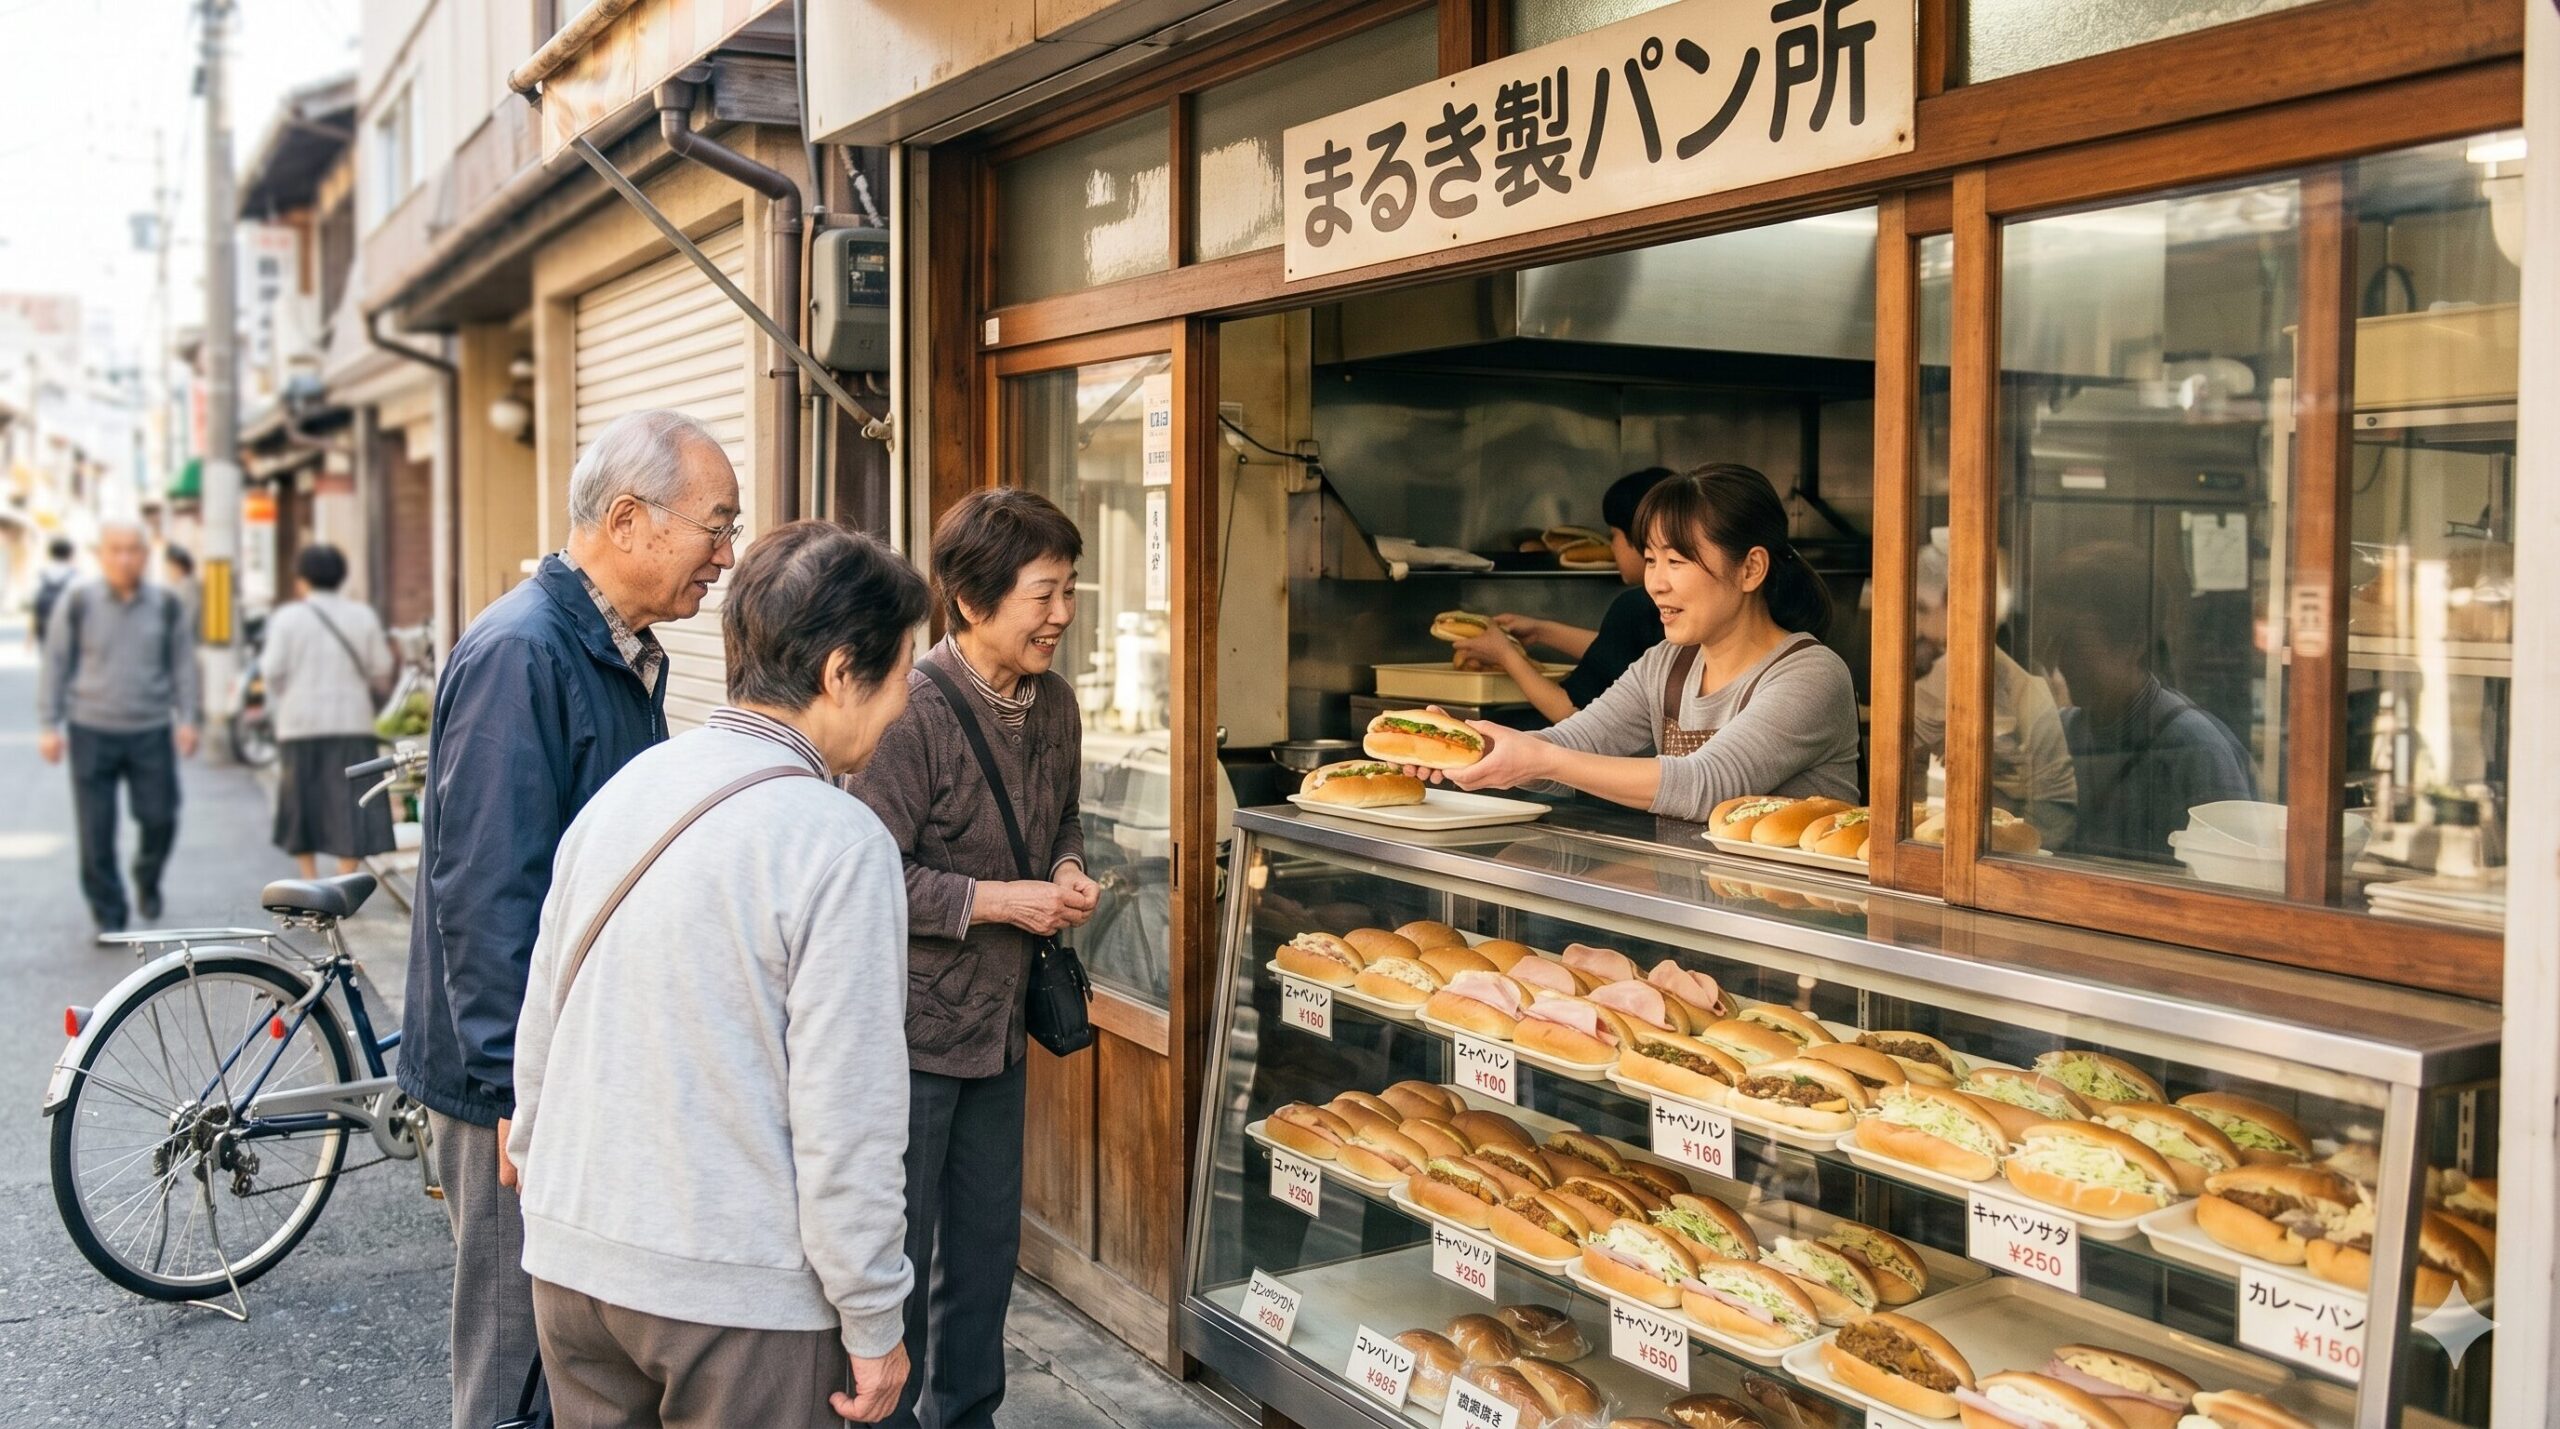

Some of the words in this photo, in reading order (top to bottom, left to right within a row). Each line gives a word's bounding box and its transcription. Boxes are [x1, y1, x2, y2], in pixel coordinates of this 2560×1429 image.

[1304, 0, 1876, 248] まるき製パン所
[1475, 1069, 1506, 1094] ¥100
[1682, 1138, 1721, 1166] ¥160
[1288, 1183, 1313, 1206] ¥250
[2008, 1241, 2061, 1276] ¥250
[2294, 1327, 2361, 1368] ¥150
[1366, 1366, 1397, 1395] ¥985
